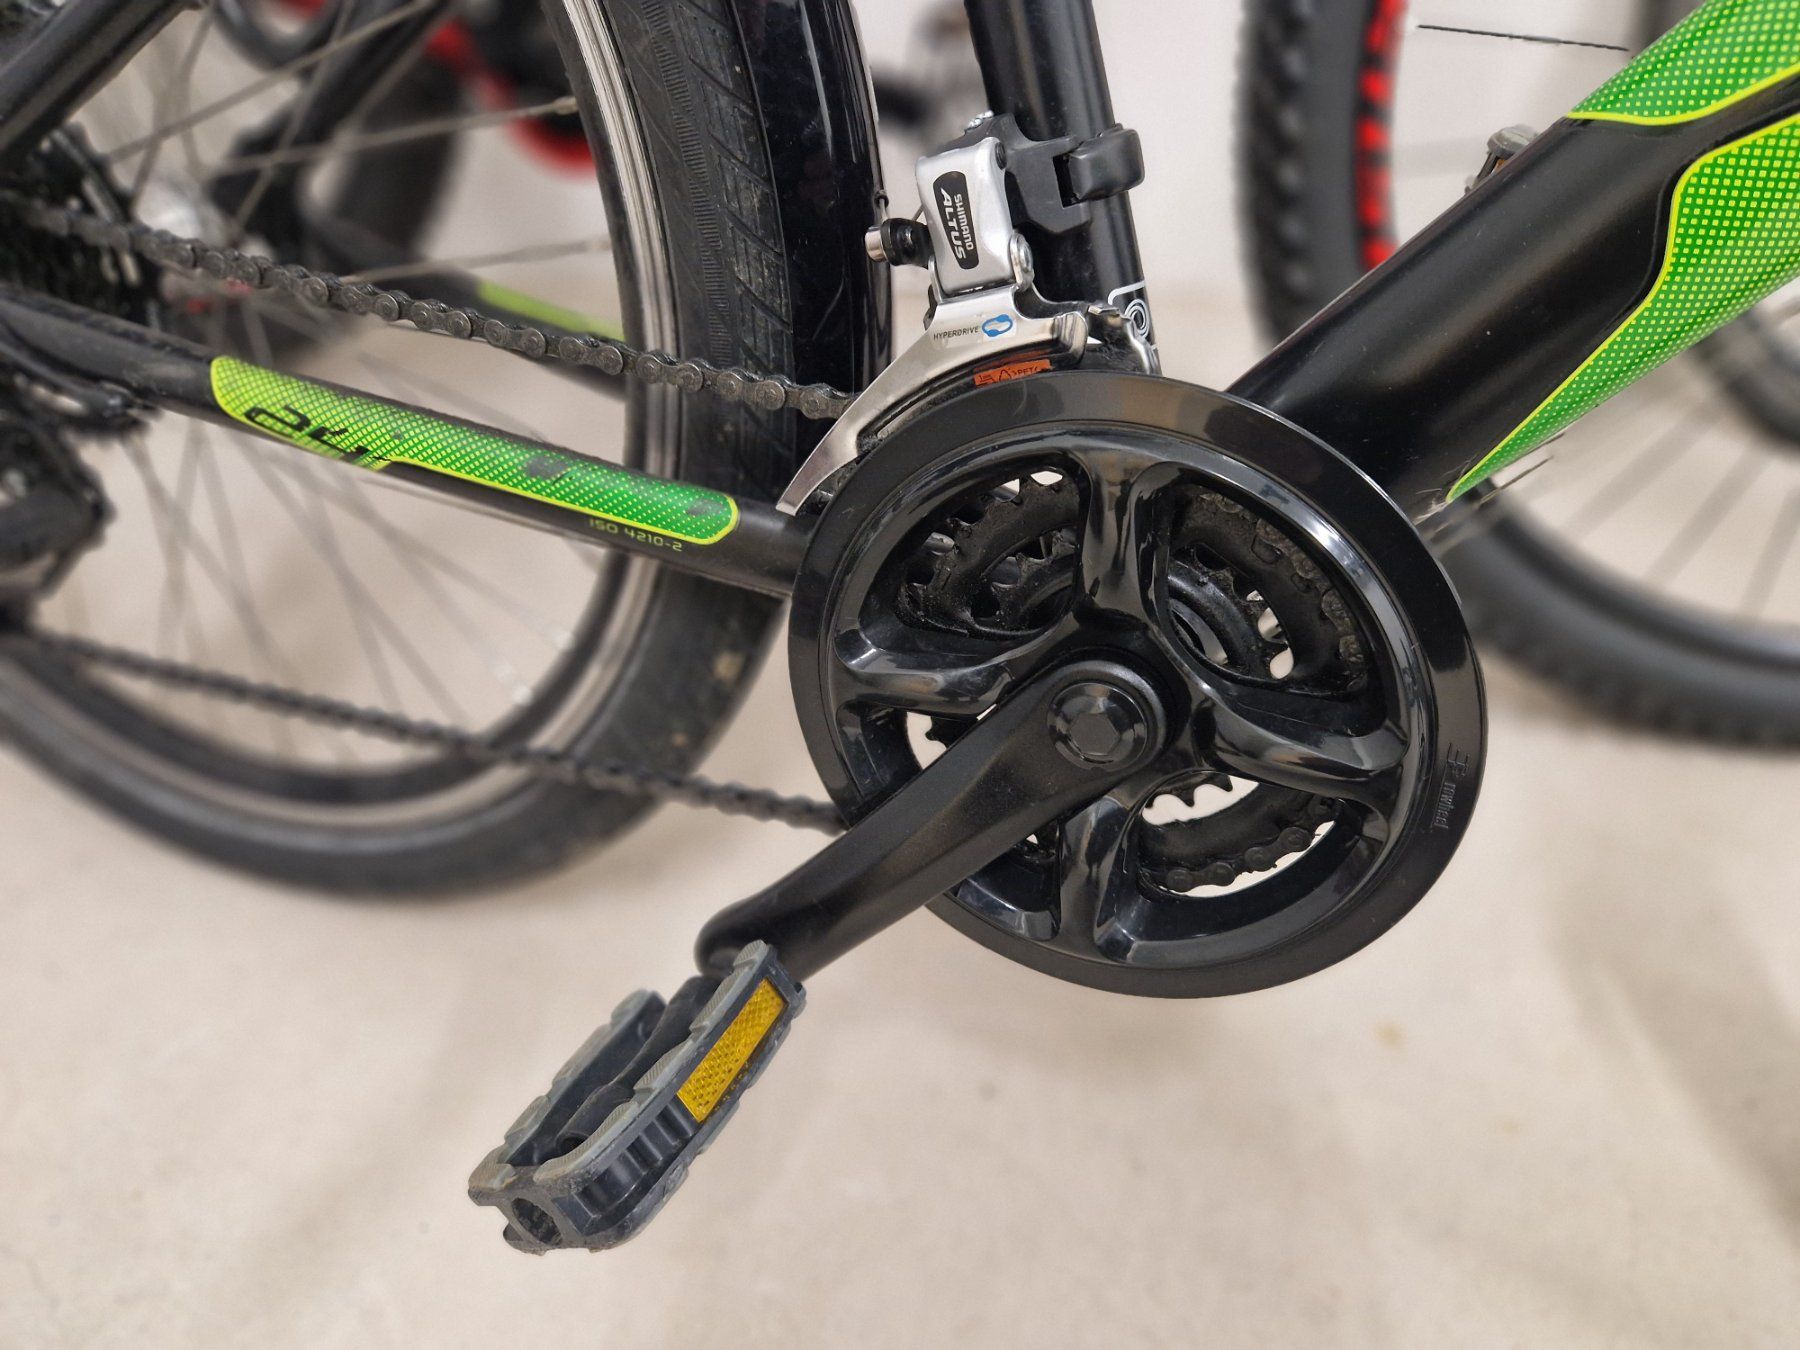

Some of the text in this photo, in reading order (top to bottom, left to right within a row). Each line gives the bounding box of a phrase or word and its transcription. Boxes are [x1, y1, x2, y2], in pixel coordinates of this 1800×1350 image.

[940, 187, 967, 259] ALTUS
[954, 193, 974, 251] SHIMANO
[933, 326, 980, 341] HYPERDRIVE
[589, 517, 683, 552] ISO 4210-2
